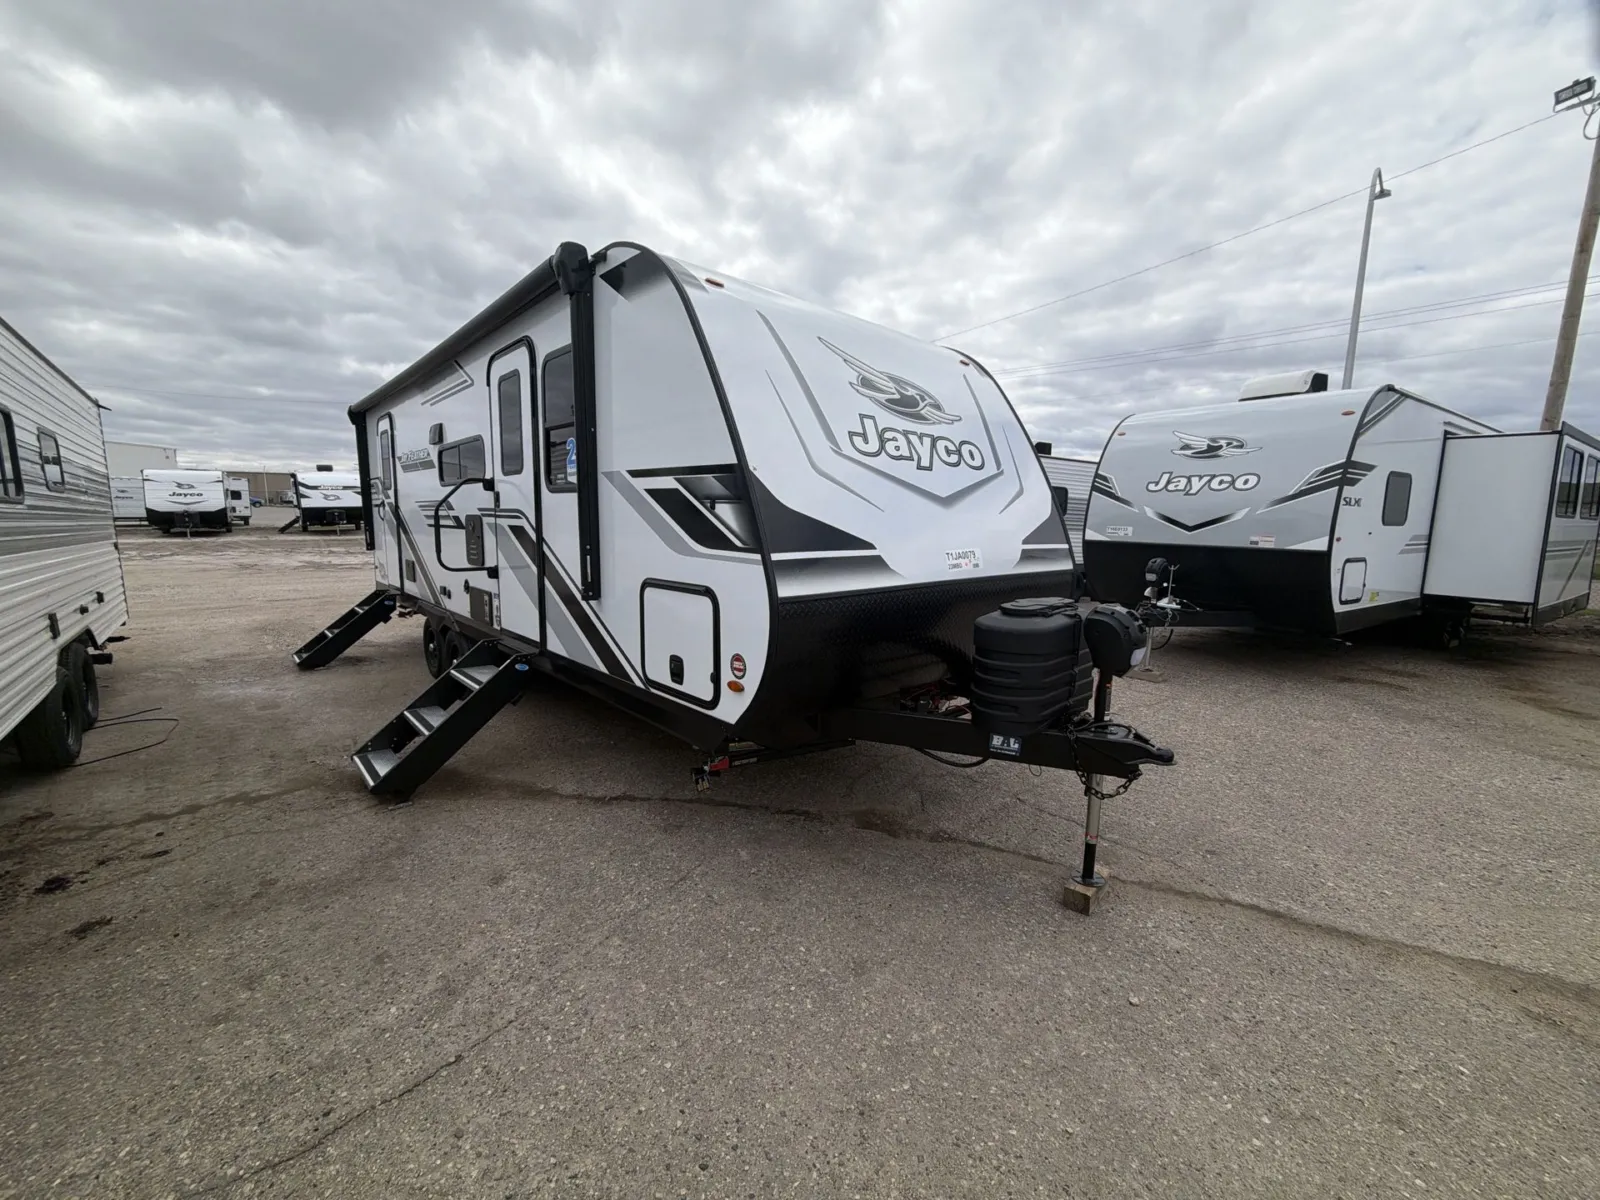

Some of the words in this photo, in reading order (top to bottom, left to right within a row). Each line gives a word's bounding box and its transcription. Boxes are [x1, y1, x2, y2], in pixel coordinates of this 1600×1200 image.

[848, 413, 985, 471] Jayco
[1146, 471, 1261, 496] Jayco
[1342, 496, 1362, 507] SLX
